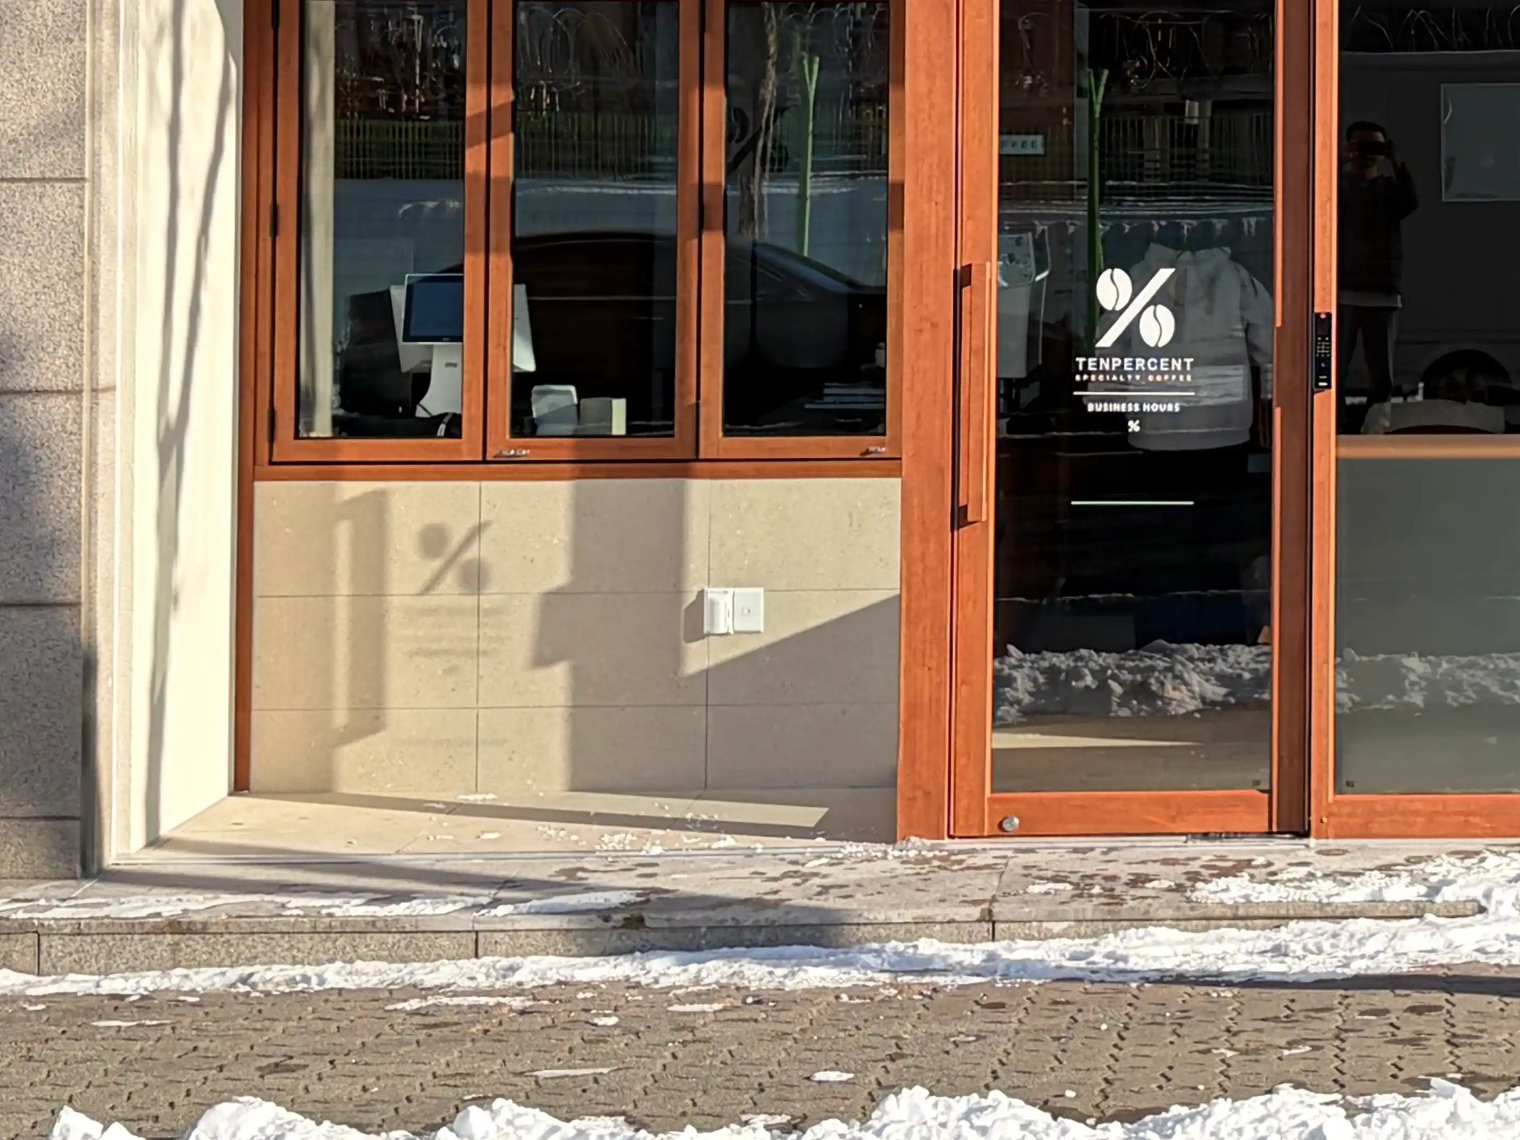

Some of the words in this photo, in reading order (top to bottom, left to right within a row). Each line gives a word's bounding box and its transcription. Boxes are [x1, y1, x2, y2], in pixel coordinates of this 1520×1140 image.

[1075, 357, 1194, 371] TENPERCENT
[1075, 374, 1141, 382] SPECIALTY
[1147, 374, 1192, 382] COFFEE
[1087, 402, 1140, 412] BUSINESS
[1143, 402, 1181, 412] HOURS
